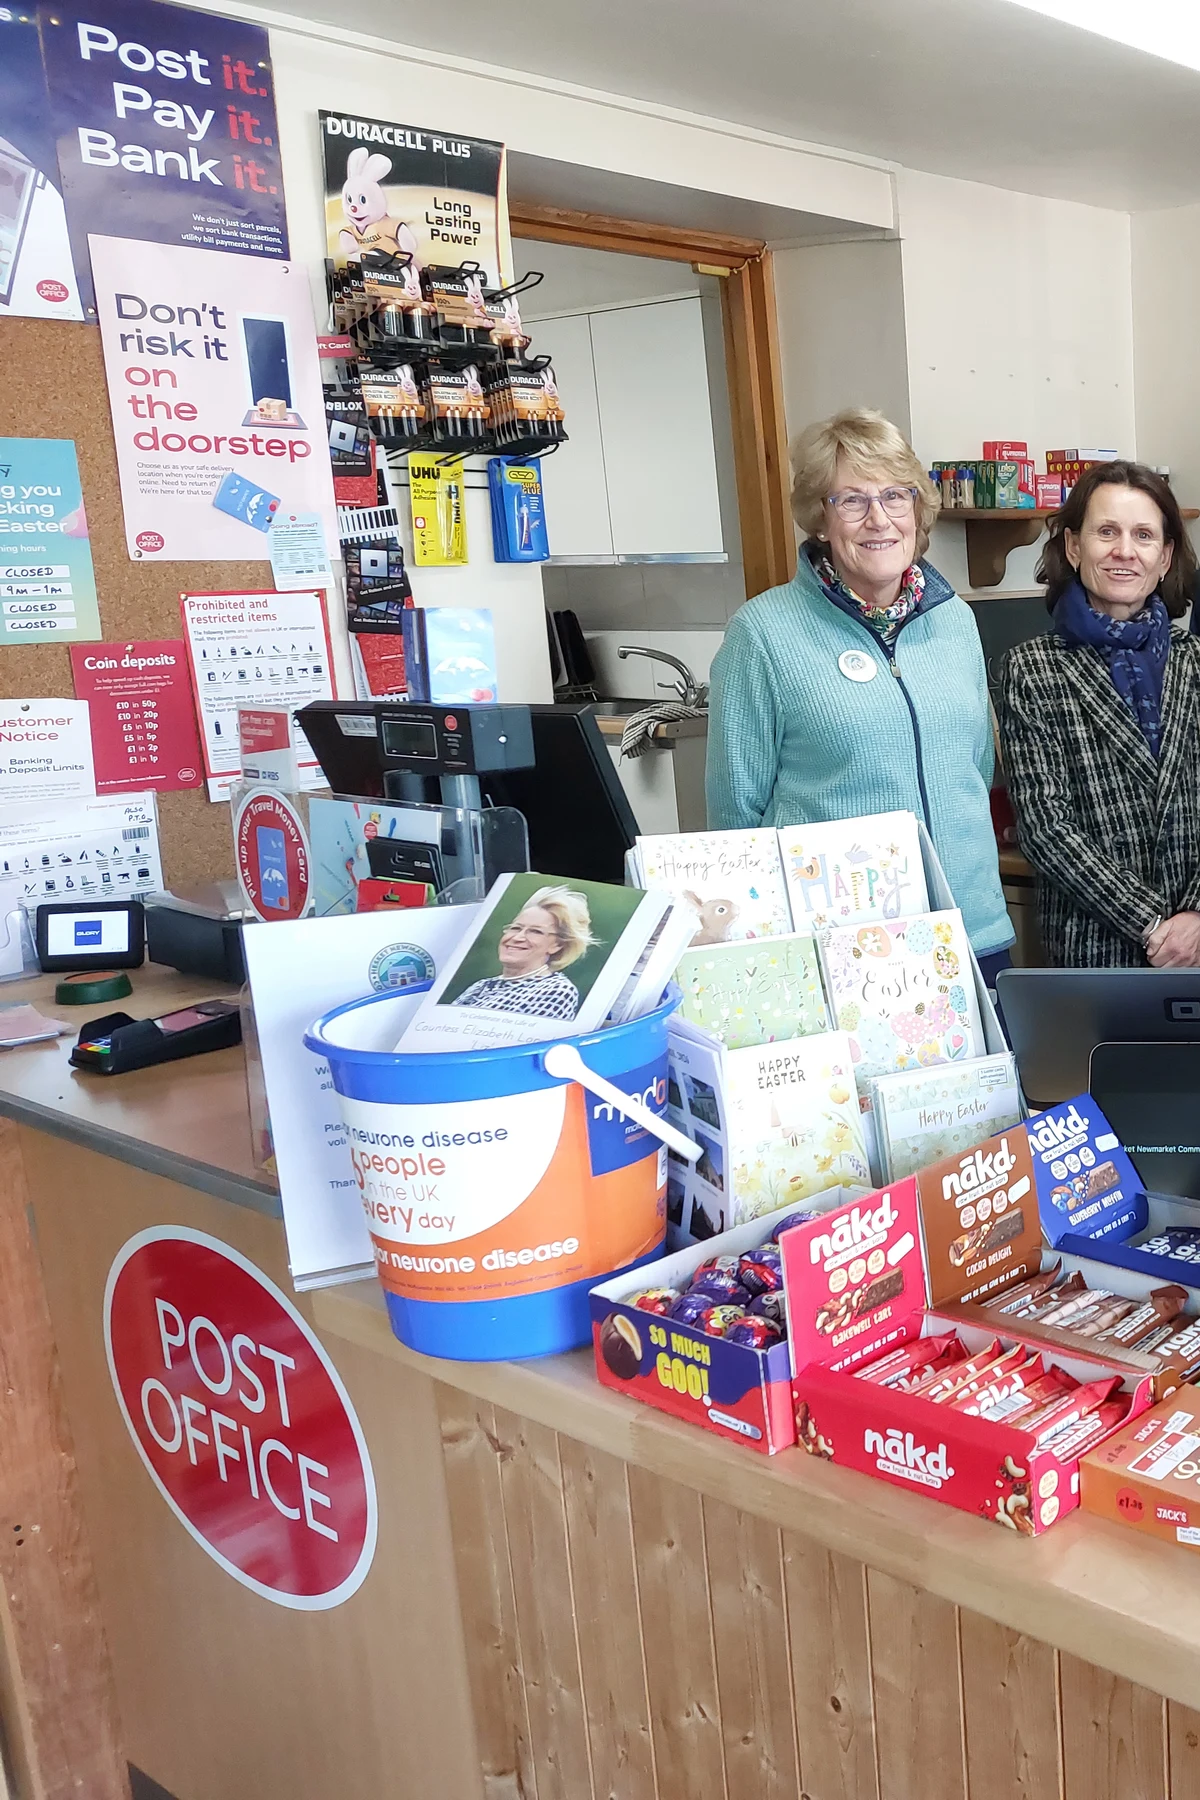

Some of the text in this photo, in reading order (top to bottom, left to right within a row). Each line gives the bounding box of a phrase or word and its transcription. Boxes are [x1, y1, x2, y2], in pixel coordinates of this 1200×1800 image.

[77, 22, 267, 97] Post it.
[113, 81, 273, 146] Pay it.
[326, 117, 471, 158] DURACELL PLUS
[78, 127, 278, 195] Bank it.
[434, 197, 471, 217] Long
[425, 212, 480, 233] Lasting
[221, 228, 239, 237] bank
[431, 228, 477, 246] Power
[216, 239, 249, 248] payments
[364, 271, 401, 283] DURACELL
[432, 281, 468, 292] DURACELL
[115, 293, 226, 329] Don't
[119, 328, 229, 361] risk it
[125, 366, 177, 388] on
[361, 373, 544, 385] DURACELL DURACELL DURACELL
[127, 394, 198, 421] the
[133, 426, 312, 463] doorstep
[411, 466, 441, 480] UHU
[23, 485, 61, 499] you
[0, 521, 67, 533] Easter
[5, 568, 54, 577] CLOSED
[9, 603, 57, 613] CLOSED
[188, 599, 268, 611] Prohibited and
[10, 621, 57, 630] CLOSED
[190, 612, 277, 624] restricted items
[84, 654, 176, 670] Coin deposits
[116, 700, 157, 710] £10 50p
[118, 711, 158, 721] £10 20p
[145, 722, 158, 731] 10p
[0, 731, 59, 742] Notice
[148, 744, 158, 753] 2p
[9, 757, 53, 766] Banking
[9, 764, 85, 774] Deposit Limits
[241, 800, 307, 883] your Travel Money Card
[660, 850, 761, 881] Happy Easter
[862, 968, 936, 1003] Easter
[414, 1021, 514, 1040] Countess Elizabeth
[757, 1055, 801, 1074] HAPPY
[757, 1072, 806, 1090] EASTER
[918, 1098, 989, 1128] Happy Easter
[352, 1128, 508, 1148] neurone disease
[1136, 1145, 1177, 1153] Newmarket
[359, 1151, 446, 1180] people
[941, 1138, 1017, 1201] nākd.
[380, 1182, 440, 1201] the UK
[361, 1194, 455, 1232] every day
[810, 1193, 898, 1264] nākd.
[391, 1237, 579, 1273] neurone disease
[649, 1324, 711, 1365] SO MUCH
[155, 1297, 295, 1428] POST
[656, 1353, 712, 1407] GOO!
[1133, 1419, 1162, 1442] JACK'S
[864, 1428, 955, 1480] nākd.
[1147, 1440, 1172, 1460] SALE
[141, 1377, 339, 1543] OFFICE
[1156, 1507, 1187, 1523] JACK'S
